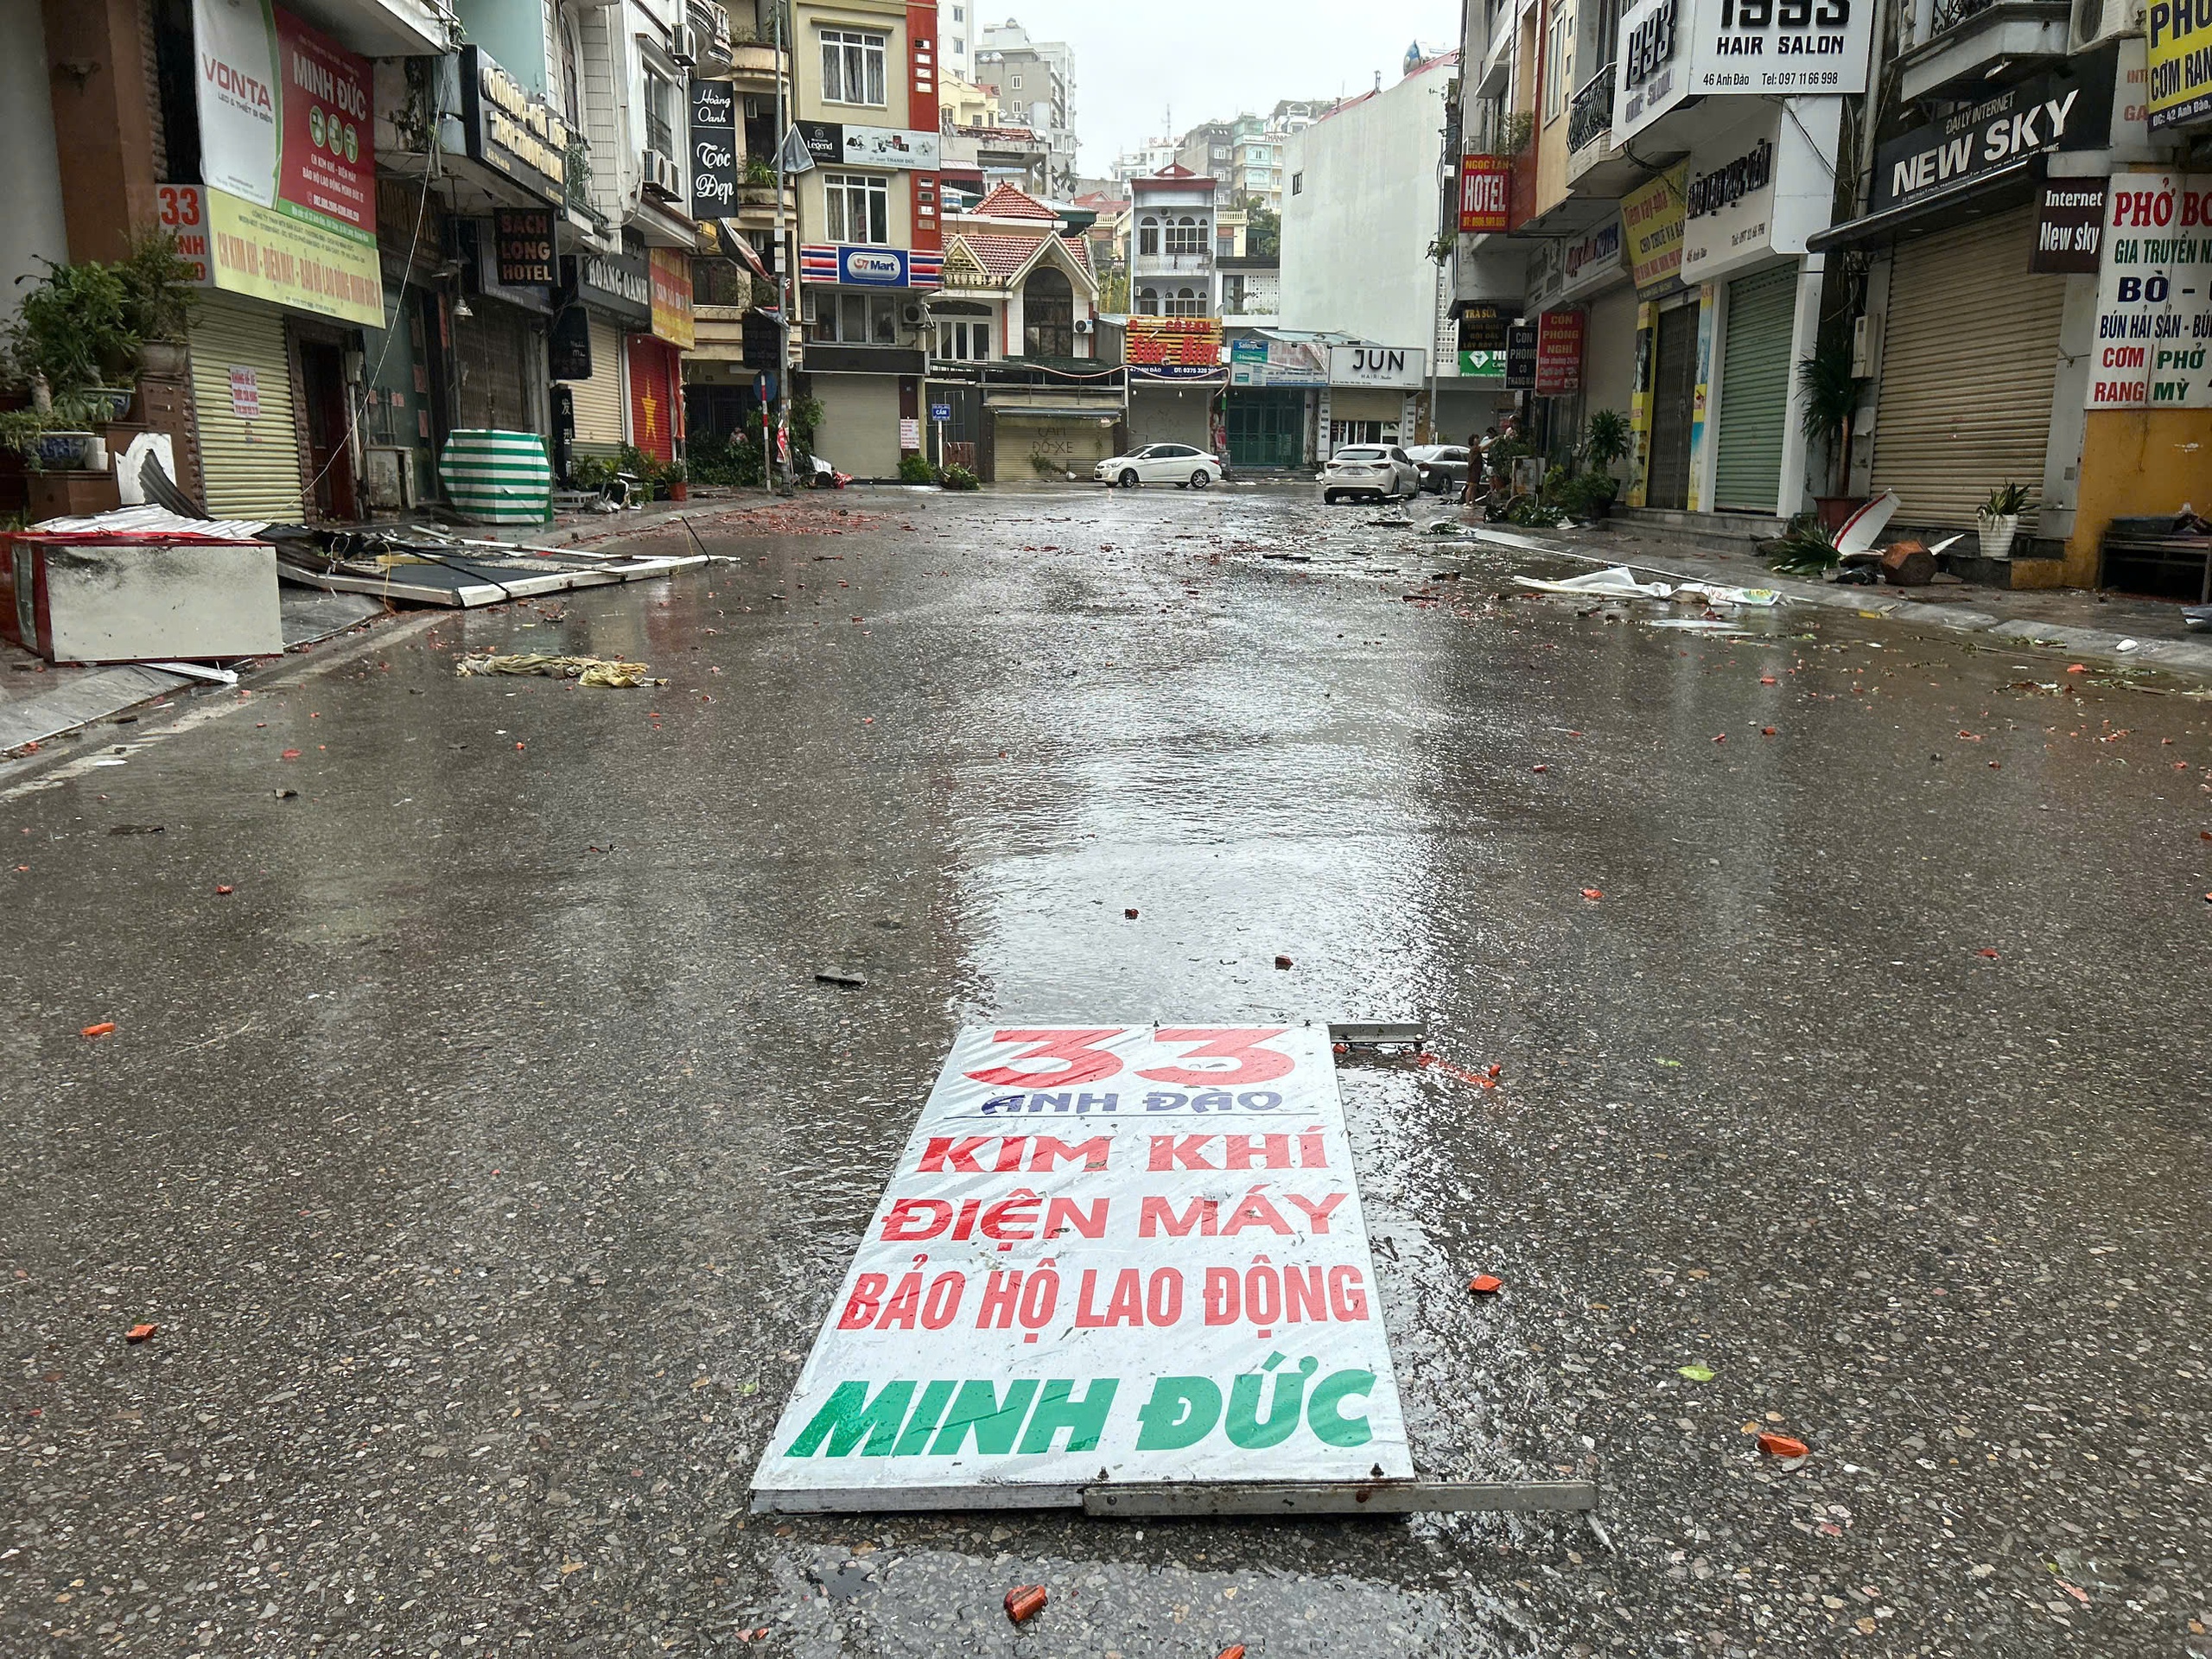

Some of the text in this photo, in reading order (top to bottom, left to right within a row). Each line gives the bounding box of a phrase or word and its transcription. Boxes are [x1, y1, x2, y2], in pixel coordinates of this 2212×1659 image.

[1717, 35, 1845, 55] HAIR SALON
[202, 52, 272, 111] VONTA
[294, 51, 334, 105] MINH
[337, 75, 366, 121] ĐỨC
[1703, 72, 1839, 86] 46 Anh Đào Tel: 097 11 66 998
[2151, 45, 2212, 102] CƠM RAN
[693, 89, 731, 108] Hoàng
[1972, 91, 2017, 123] INTERNET
[2166, 109, 2177, 122] 42
[2177, 105, 2192, 118] Anh
[698, 106, 727, 123] Oanh
[696, 143, 732, 169] Tóc
[807, 140, 833, 151] Legend
[1892, 132, 1974, 198] NEW
[1984, 89, 2080, 162] SKY
[696, 174, 734, 205] Đẹp
[1464, 175, 1506, 213] HOTEL
[2045, 190, 2103, 207] Internet
[2113, 176, 2176, 227] PHỞ
[160, 187, 200, 226] 33
[175, 235, 205, 255] NH
[502, 241, 551, 260] LONG
[2039, 221, 2100, 254] New sky
[2114, 230, 2197, 264] GIA TRUYỀN
[503, 264, 553, 281] HOTEL
[870, 260, 895, 271] Mart
[623, 271, 649, 306] OANH
[2118, 270, 2169, 302] BÒ
[1465, 306, 1481, 319] TRÀ
[2100, 310, 2127, 339] BÚN
[2130, 305, 2152, 339] HẢI
[2154, 305, 2182, 339] SẢN
[1352, 349, 1404, 372] JUN
[2102, 341, 2206, 370] CƠM PHỞ
[2094, 378, 2190, 403] RANG MỲ
[962, 1028, 1295, 1089] 33
[980, 1090, 1284, 1116] ANH ĐÀO
[913, 1124, 1330, 1174] KIM KHÍ
[879, 1183, 1351, 1252] ĐIỆN MÁY
[836, 1252, 1371, 1344] BẢO HỘ LAO ĐỘNG
[783, 1350, 1378, 1459] MINH ĐỨC
